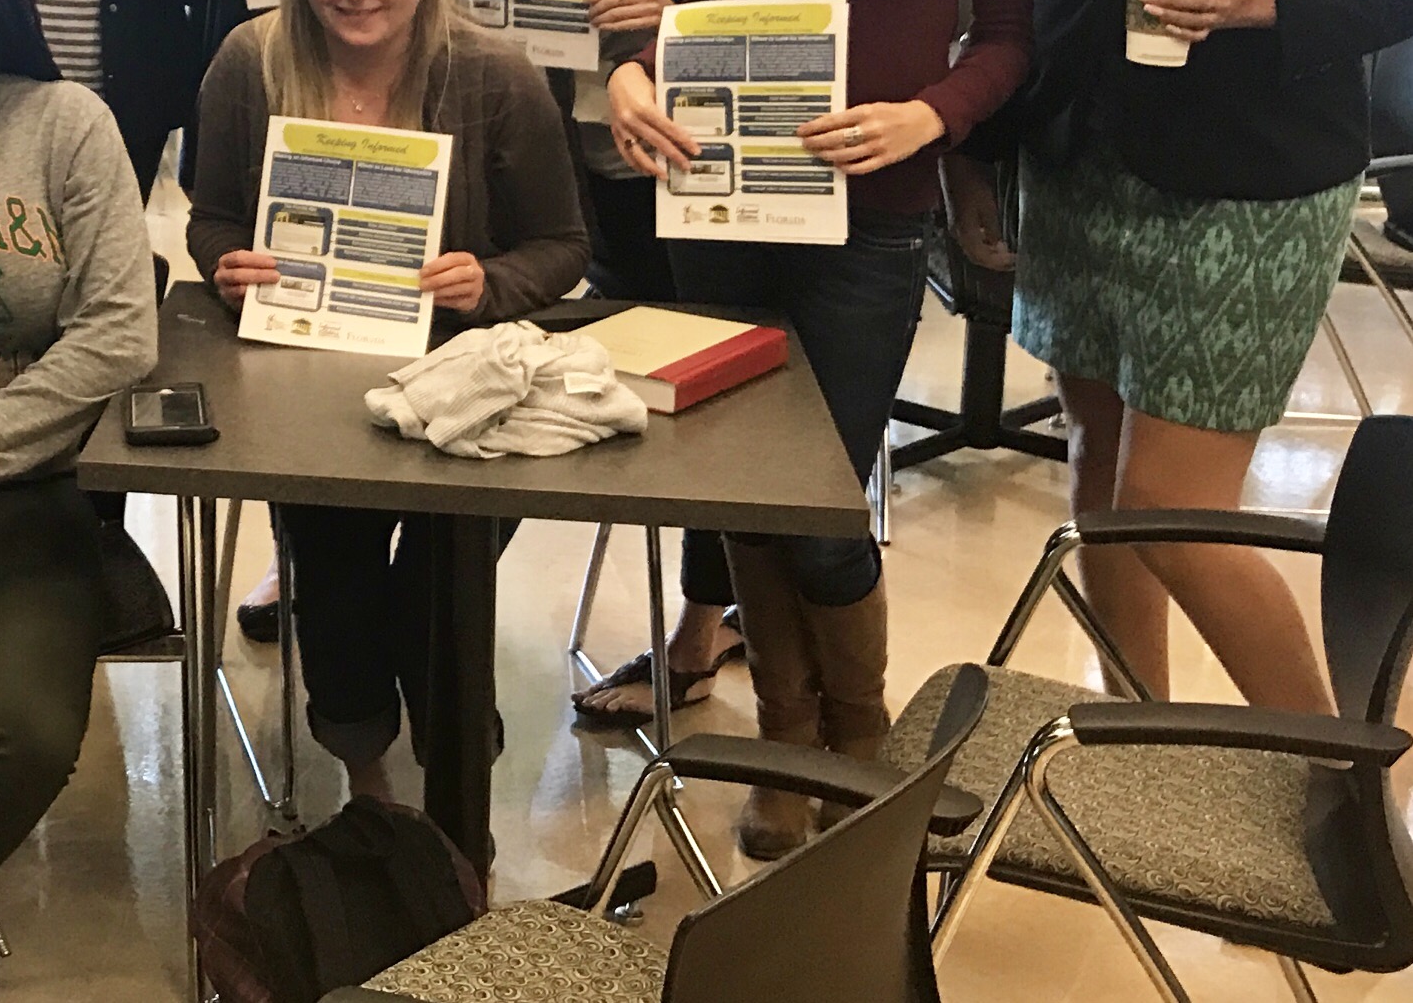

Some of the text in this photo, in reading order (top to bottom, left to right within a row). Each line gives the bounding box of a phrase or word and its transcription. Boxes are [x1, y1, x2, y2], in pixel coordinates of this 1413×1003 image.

[706, 11, 801, 26] Keeping Informed
[316, 133, 410, 154] Keeping Informed
